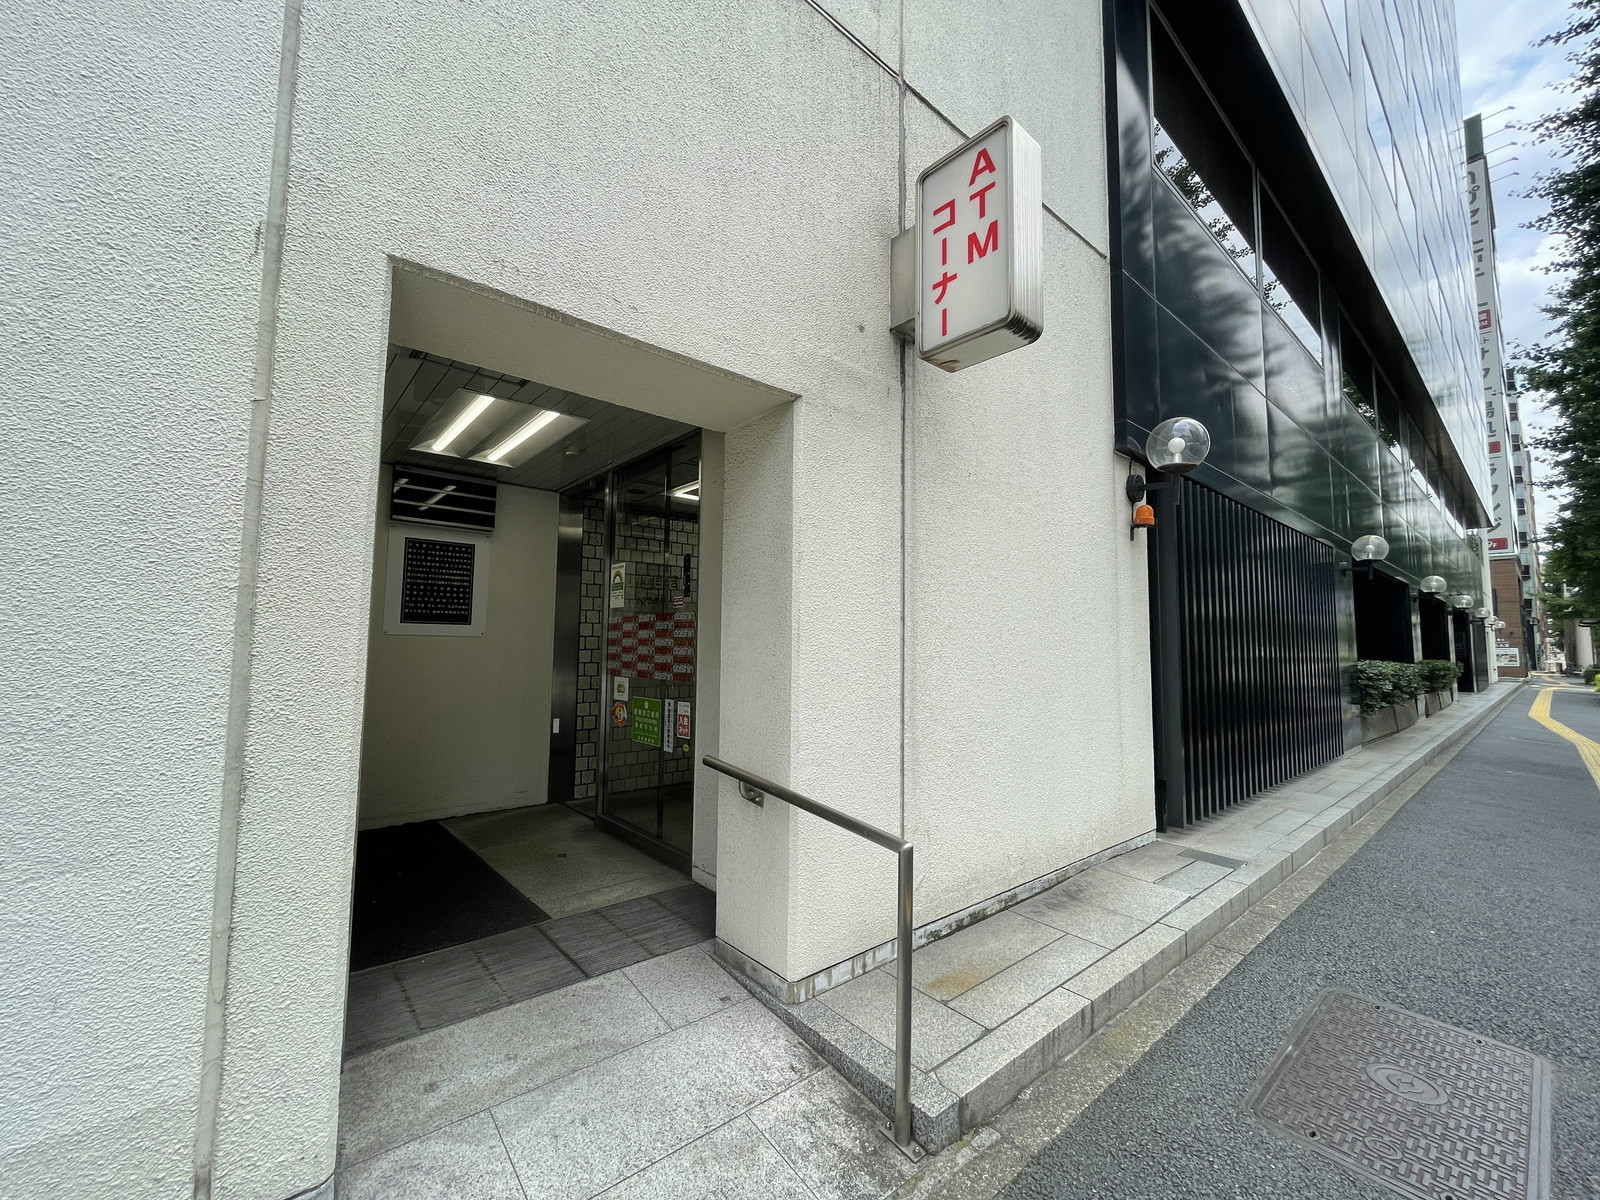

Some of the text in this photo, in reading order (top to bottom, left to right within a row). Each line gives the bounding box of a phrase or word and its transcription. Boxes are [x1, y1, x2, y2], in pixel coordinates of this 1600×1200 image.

[932, 198, 958, 337] コーナー
[968, 147, 999, 265] ATM
